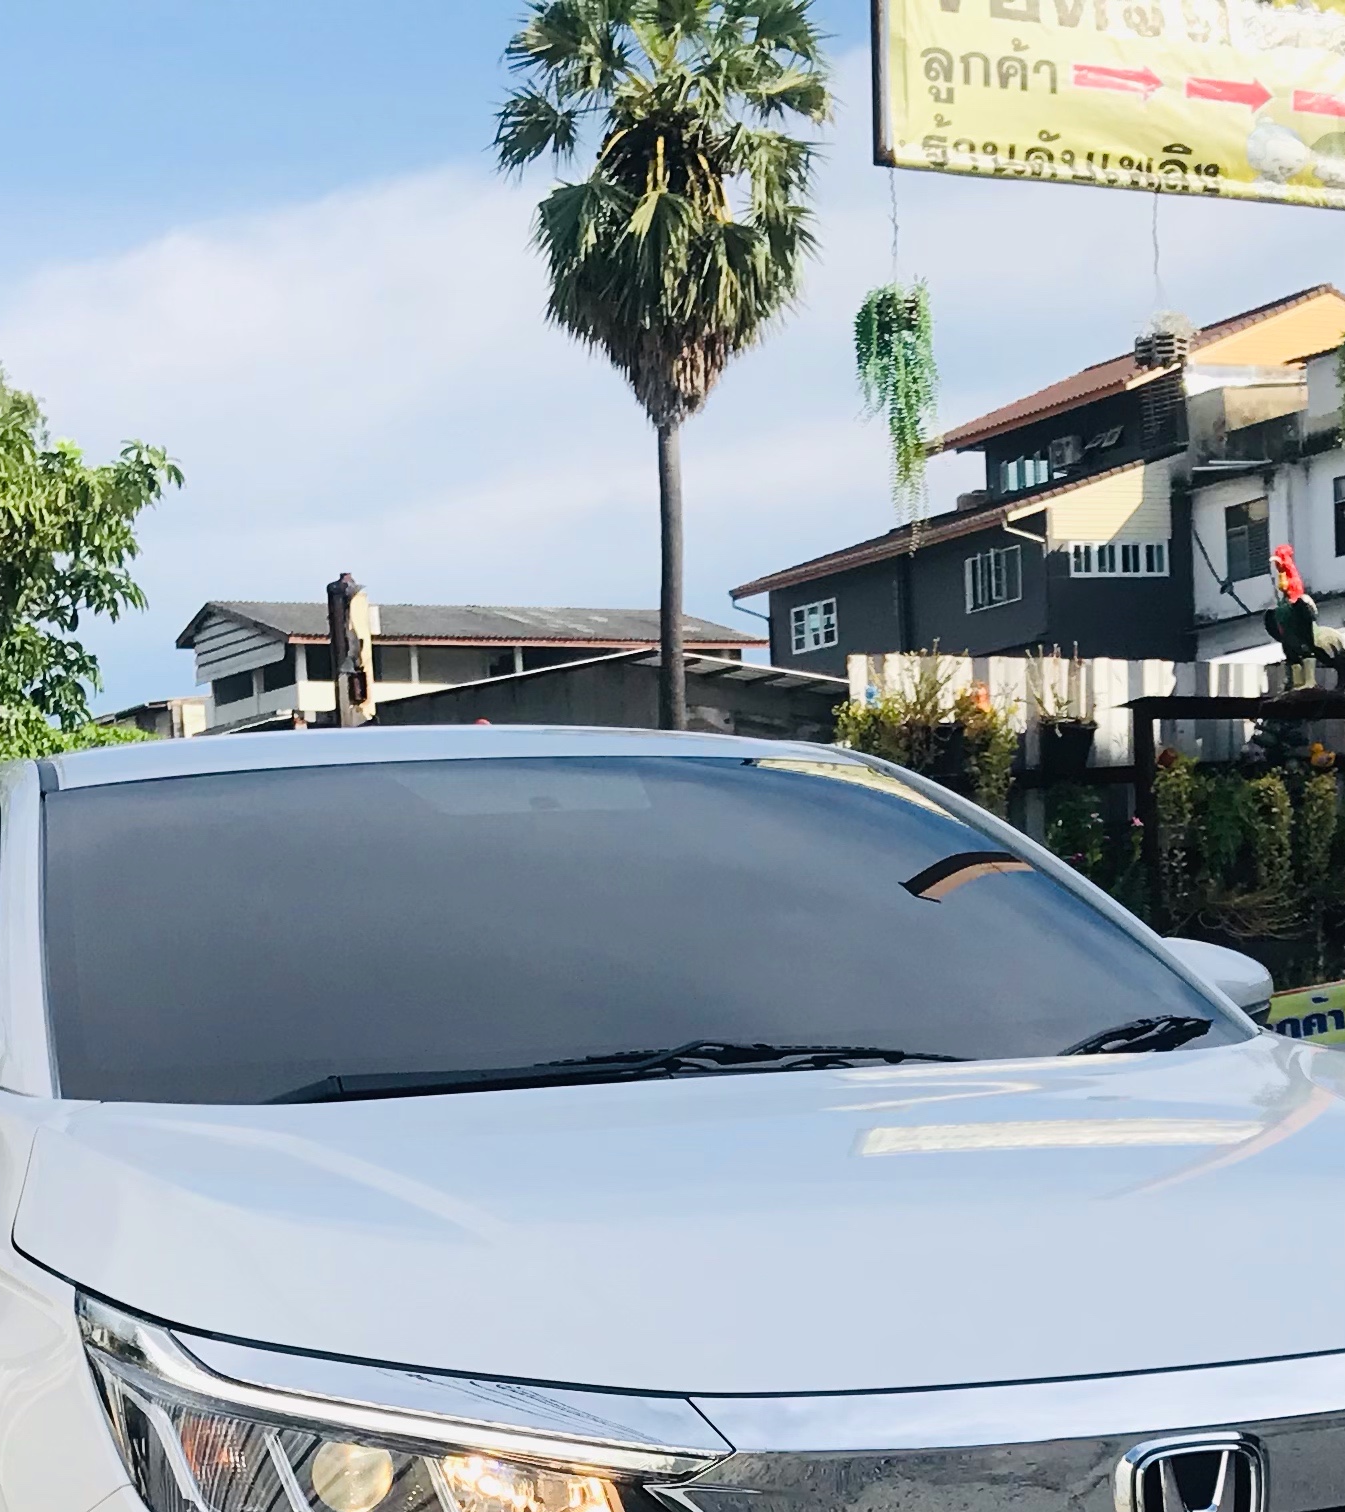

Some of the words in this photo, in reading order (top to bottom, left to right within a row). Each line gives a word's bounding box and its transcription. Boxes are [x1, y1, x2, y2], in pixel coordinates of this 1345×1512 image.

[920, 37, 1058, 104] ลูกค้า
[1262, 996, 1345, 1039] กค้า
